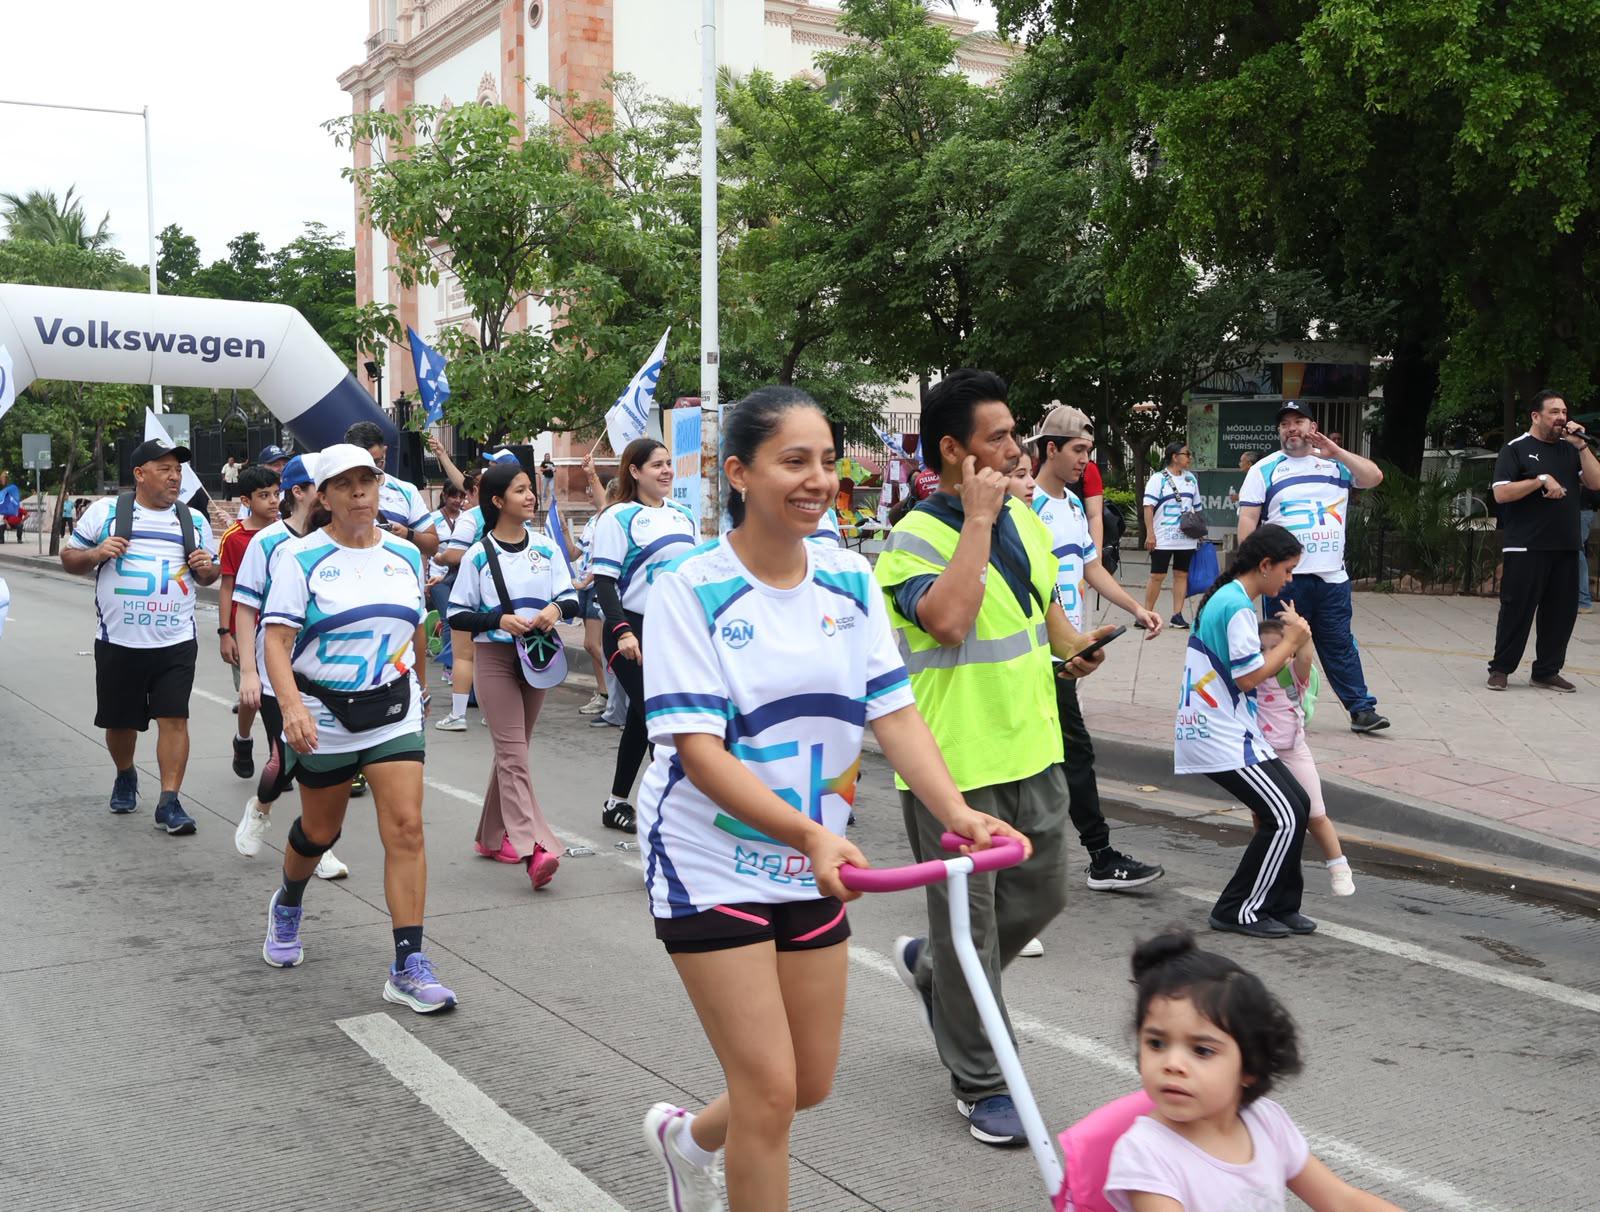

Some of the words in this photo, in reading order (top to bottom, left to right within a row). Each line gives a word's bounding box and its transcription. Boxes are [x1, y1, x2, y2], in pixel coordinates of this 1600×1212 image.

[33, 316, 266, 363] Volkswagen
[1226, 423, 1263, 432] MÓDULO
[1264, 424, 1277, 432] DE
[1222, 433, 1280, 441] INFORMACIÓN
[1229, 442, 1272, 450] TURÍSTICO
[114, 552, 190, 597] 5K
[319, 567, 340, 580] PAN
[123, 613, 180, 626] 2026
[721, 624, 754, 643] PAN
